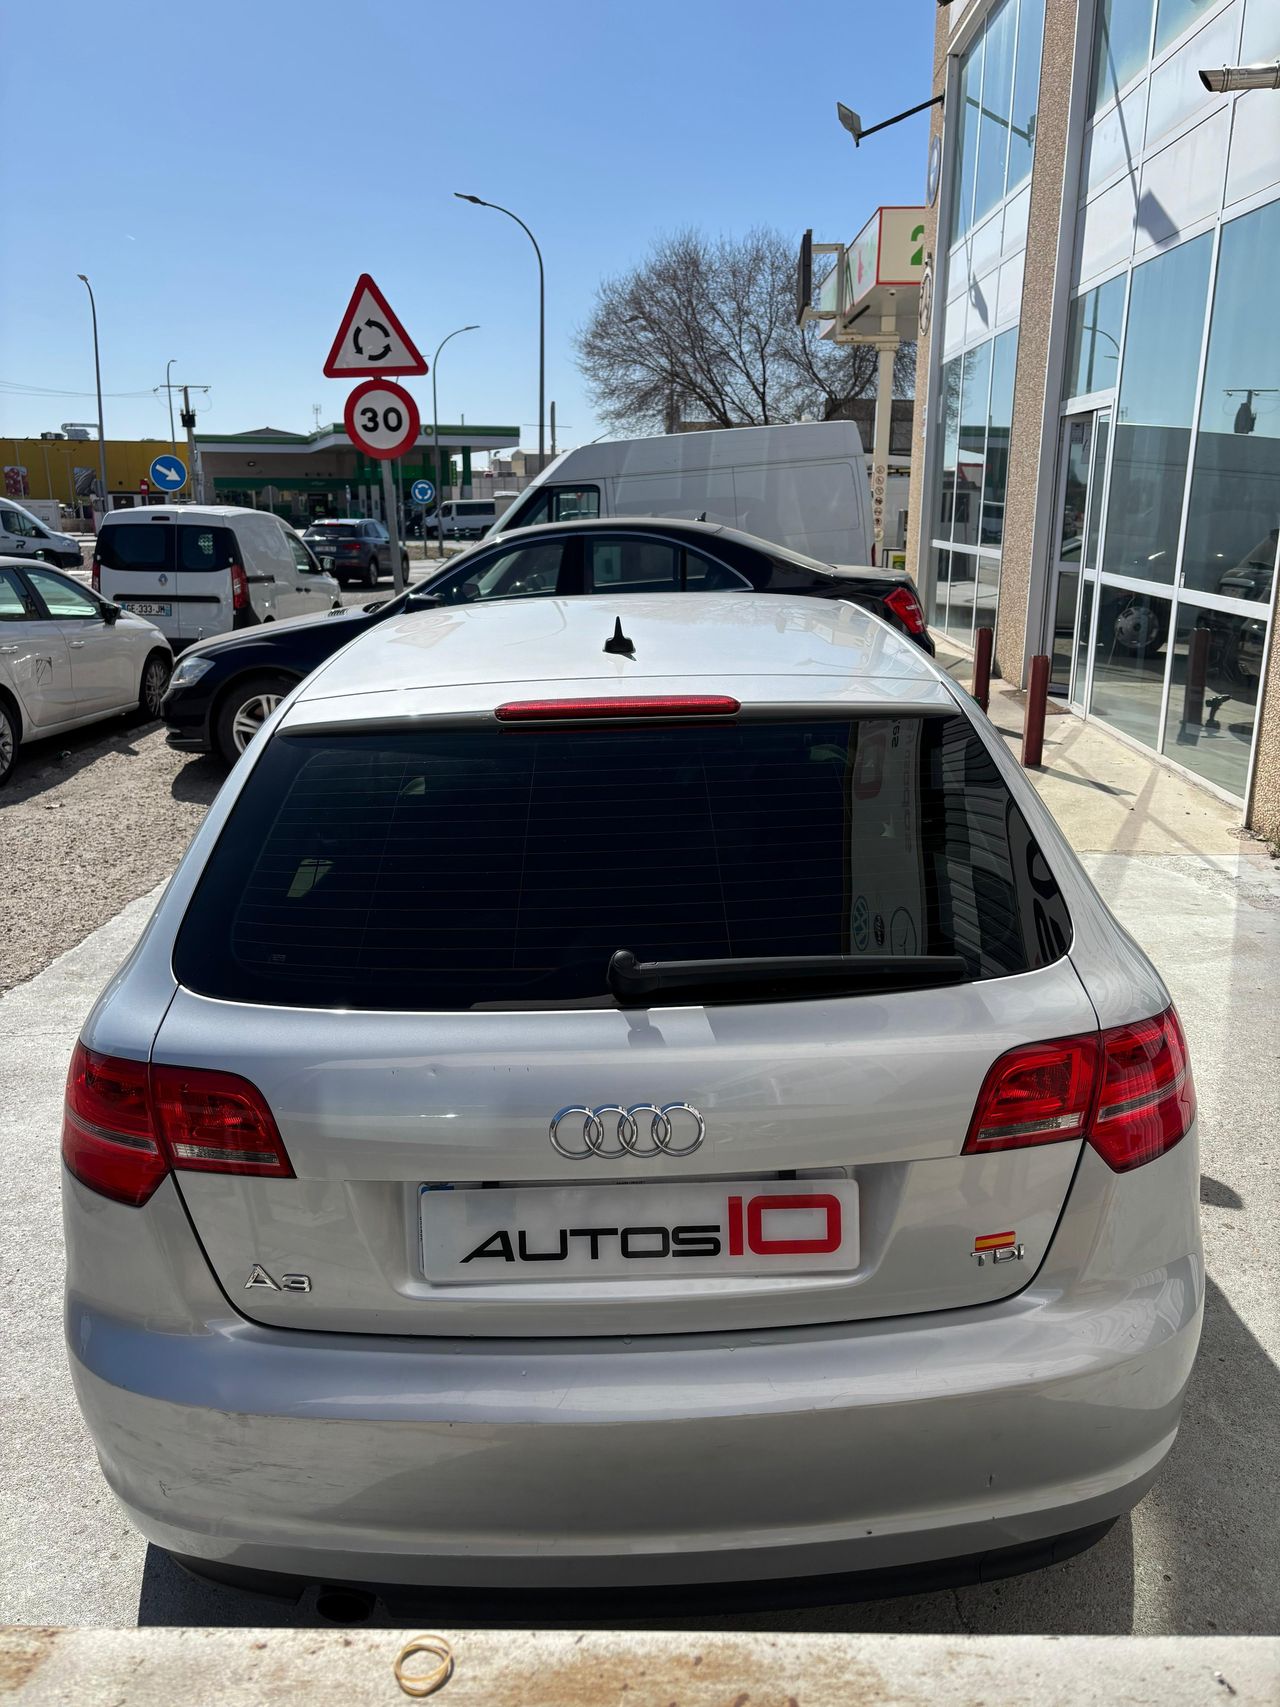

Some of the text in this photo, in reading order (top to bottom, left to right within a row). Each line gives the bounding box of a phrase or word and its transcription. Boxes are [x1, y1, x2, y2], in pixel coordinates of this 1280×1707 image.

[360, 407, 403, 433] 30
[15, 540, 26, 549] R
[970, 1243, 1025, 1266] TDI
[244, 1263, 313, 1294] A3
